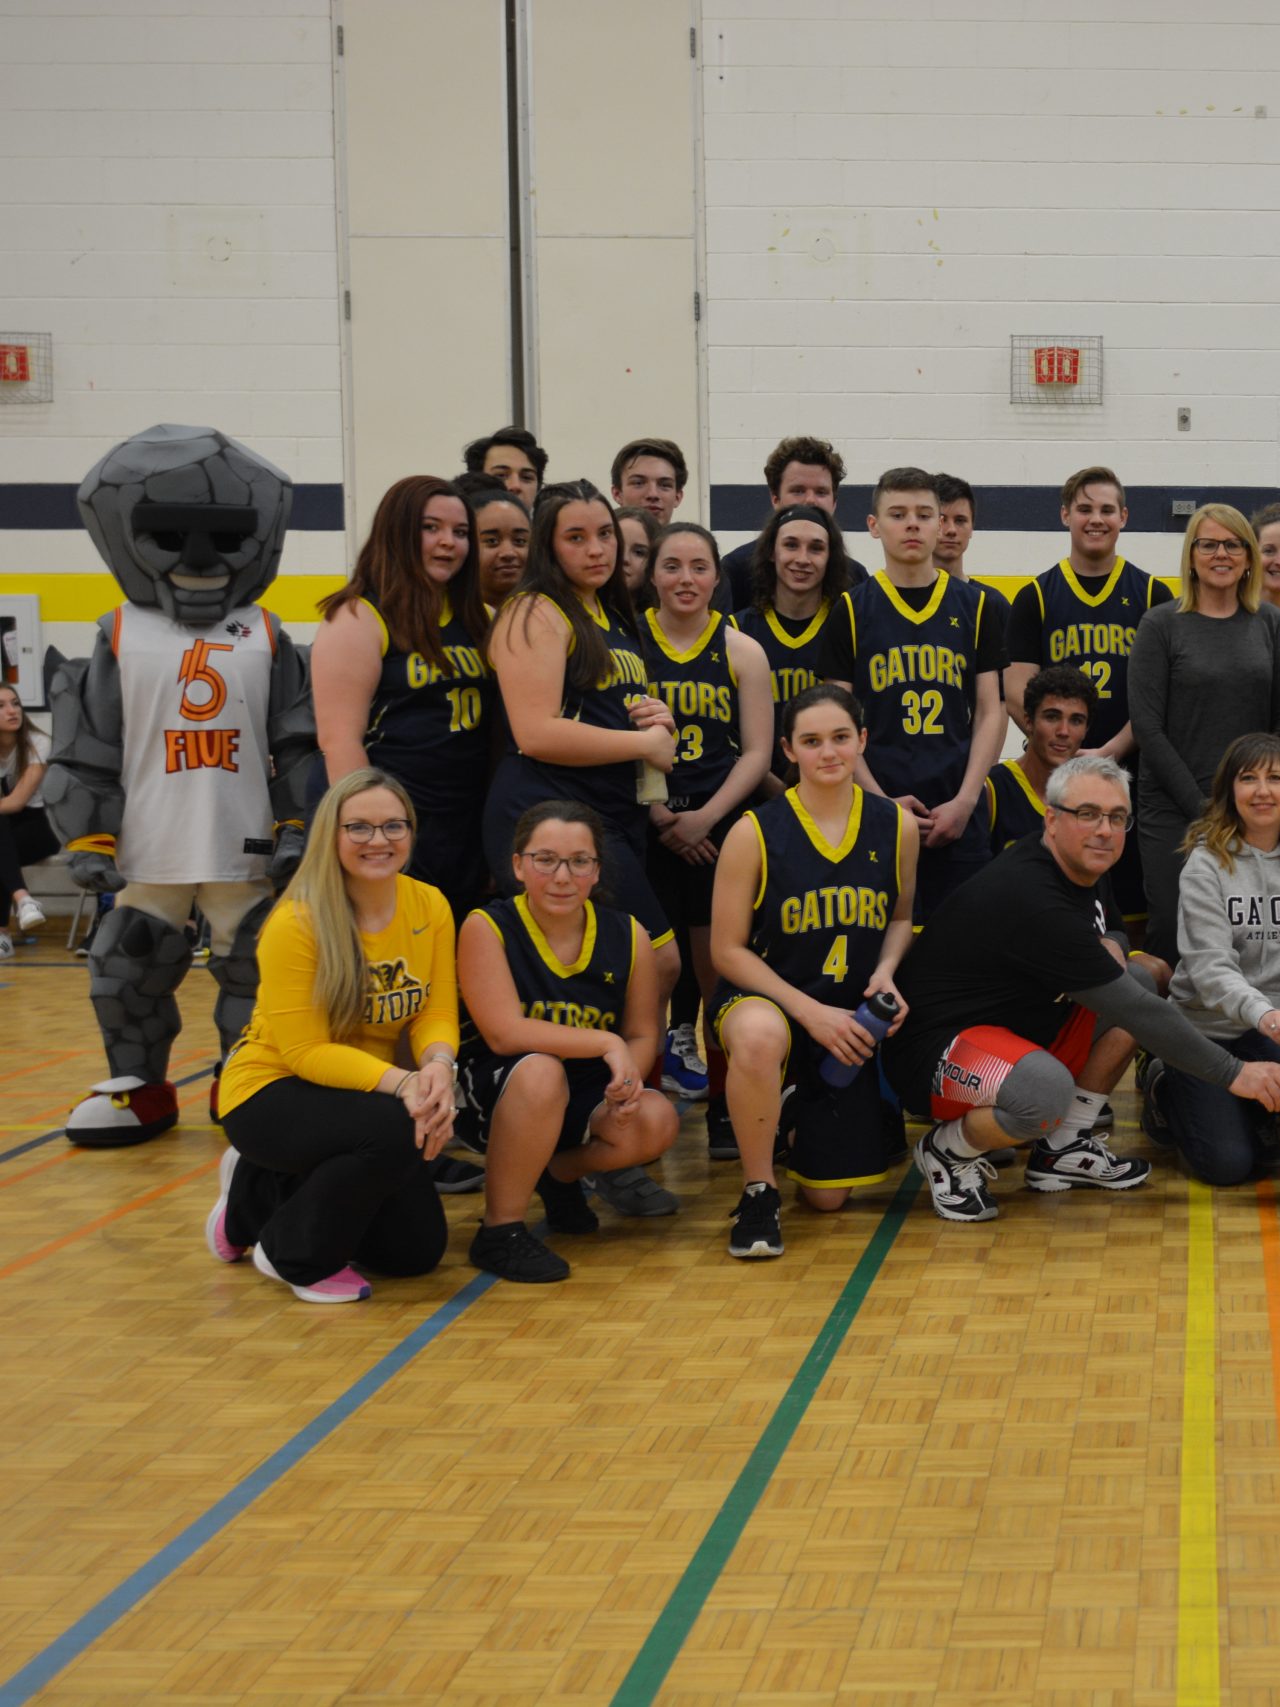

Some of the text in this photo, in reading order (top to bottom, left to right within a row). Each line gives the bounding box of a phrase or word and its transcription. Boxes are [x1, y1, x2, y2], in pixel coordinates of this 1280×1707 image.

[868, 643, 967, 692] GATORS
[1079, 660, 1112, 699] 12
[446, 687, 482, 732] 10
[902, 690, 944, 735] 32
[164, 729, 241, 774] FIVE
[780, 885, 889, 935] GATORS
[822, 935, 849, 983] 4
